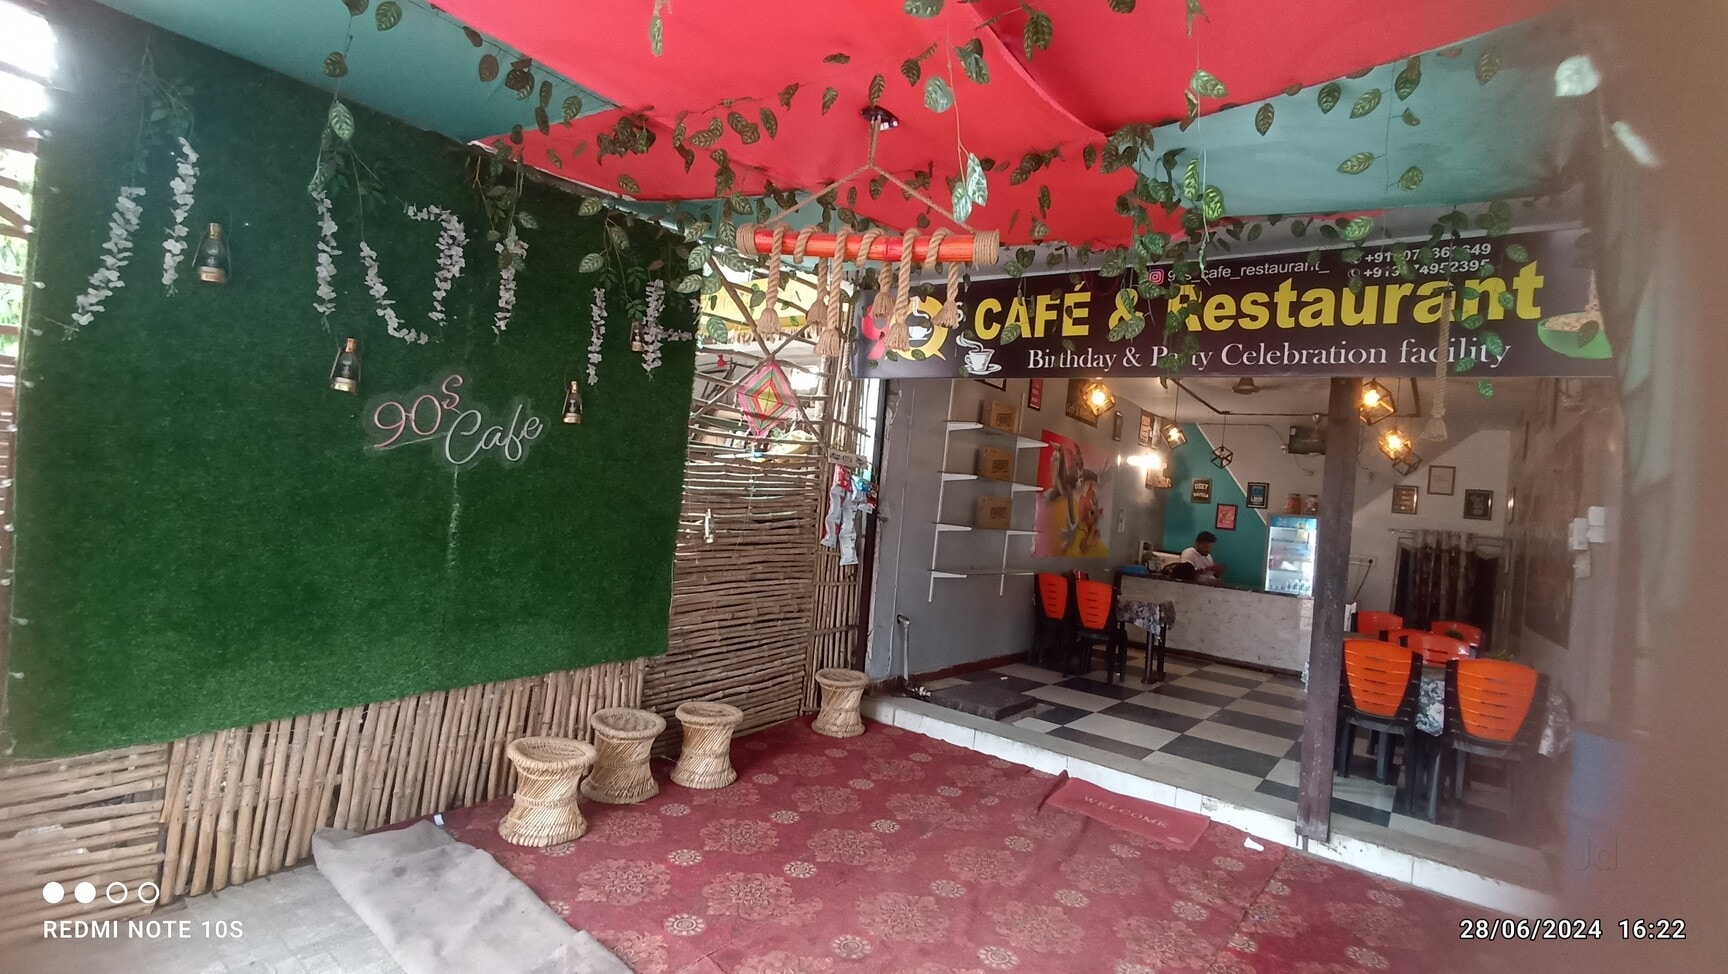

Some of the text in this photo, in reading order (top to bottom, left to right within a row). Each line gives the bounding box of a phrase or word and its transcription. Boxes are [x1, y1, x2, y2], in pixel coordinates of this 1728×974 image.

[1365, 243, 1491, 263] +91073649
[1167, 261, 1330, 283] 9s_cafe_restaurant_
[1364, 259, 1489, 278] +914952395
[974, 281, 1092, 340] CAFÉ
[1108, 288, 1145, 333] &
[1166, 260, 1545, 332] Restaurant
[1122, 346, 1142, 367] &
[1151, 345, 1213, 371] Pty
[1221, 340, 1387, 366] Celebration
[1397, 337, 1512, 368] facility
[445, 404, 544, 465] Cafe
